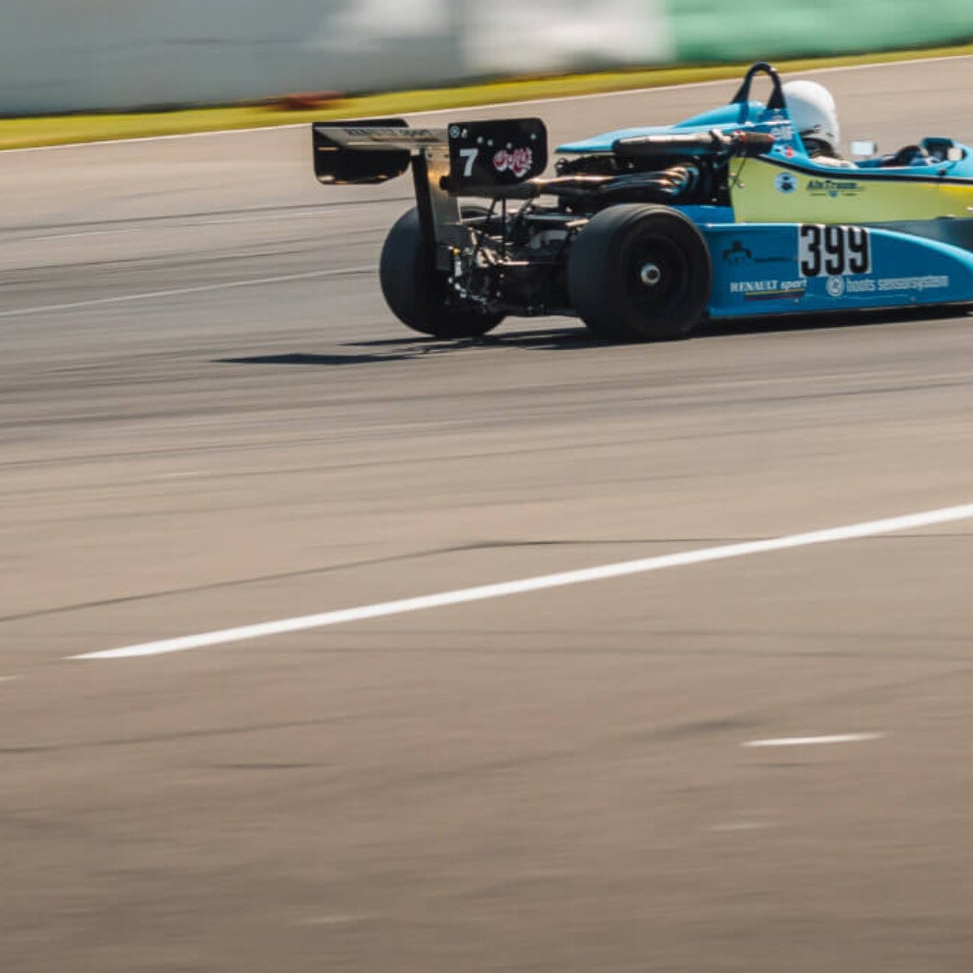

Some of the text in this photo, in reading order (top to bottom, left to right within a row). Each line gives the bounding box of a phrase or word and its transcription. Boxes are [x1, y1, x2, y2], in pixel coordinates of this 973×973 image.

[459, 148, 479, 177] 7
[800, 225, 868, 277] 399
[729, 279, 808, 293] RENAULT sport
